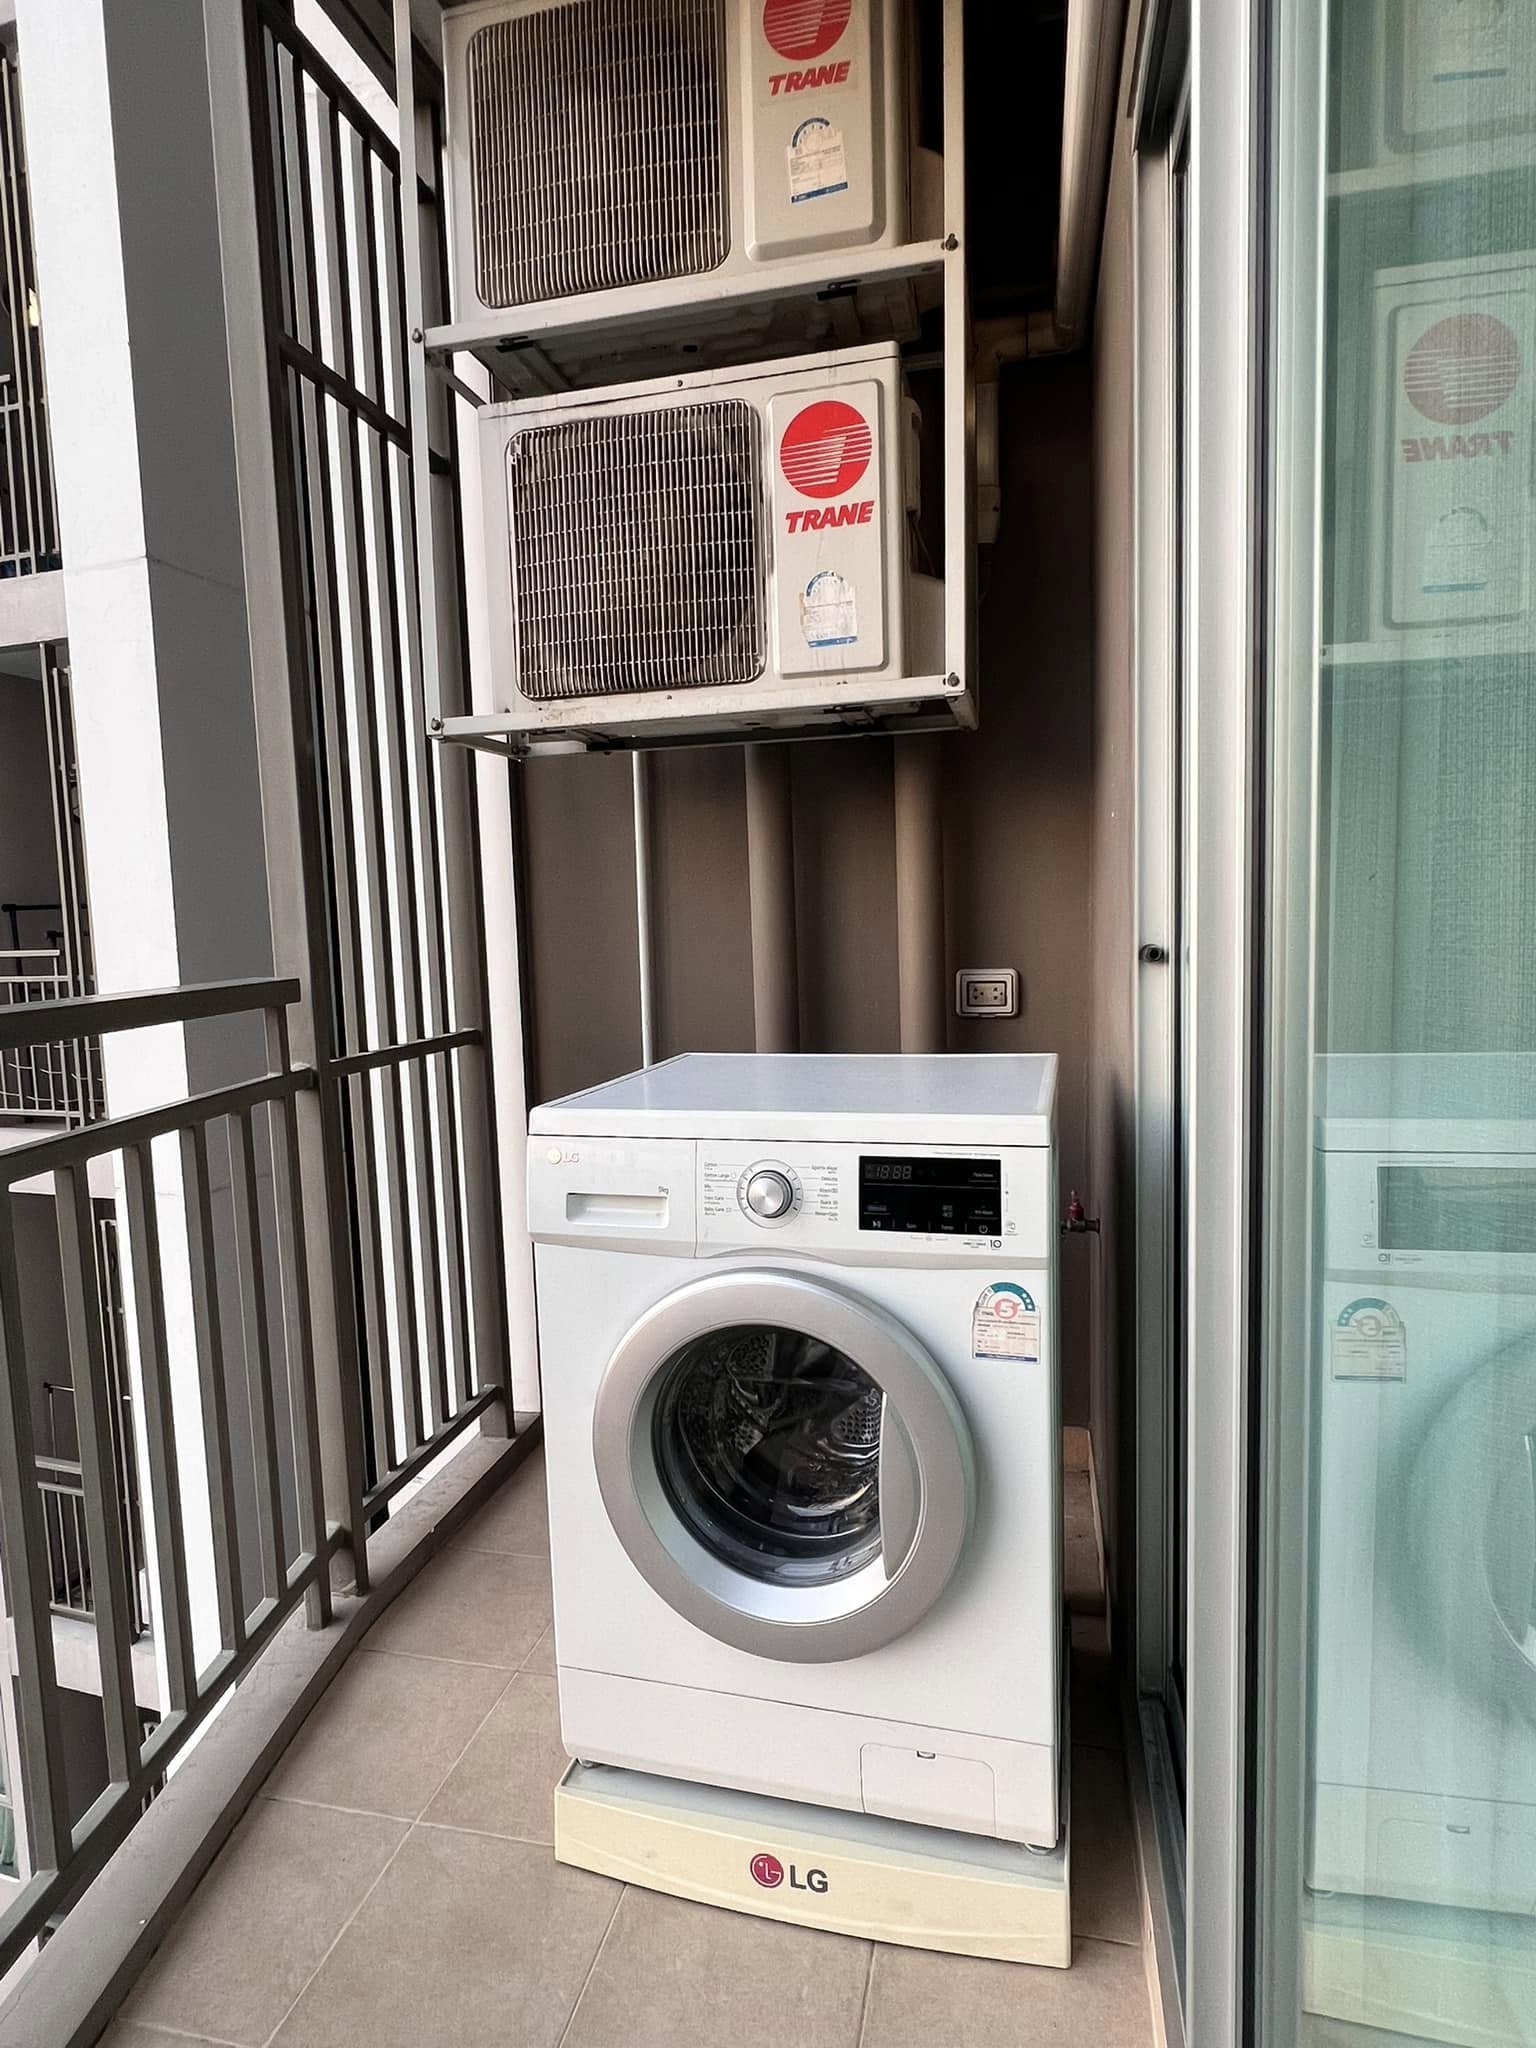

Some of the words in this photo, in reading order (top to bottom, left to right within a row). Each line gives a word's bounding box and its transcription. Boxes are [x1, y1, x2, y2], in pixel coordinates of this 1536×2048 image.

[769, 61, 851, 96] TRANE
[785, 500, 875, 533] TRANE
[563, 1151, 580, 1163] LG
[790, 1864, 829, 1894] LG
